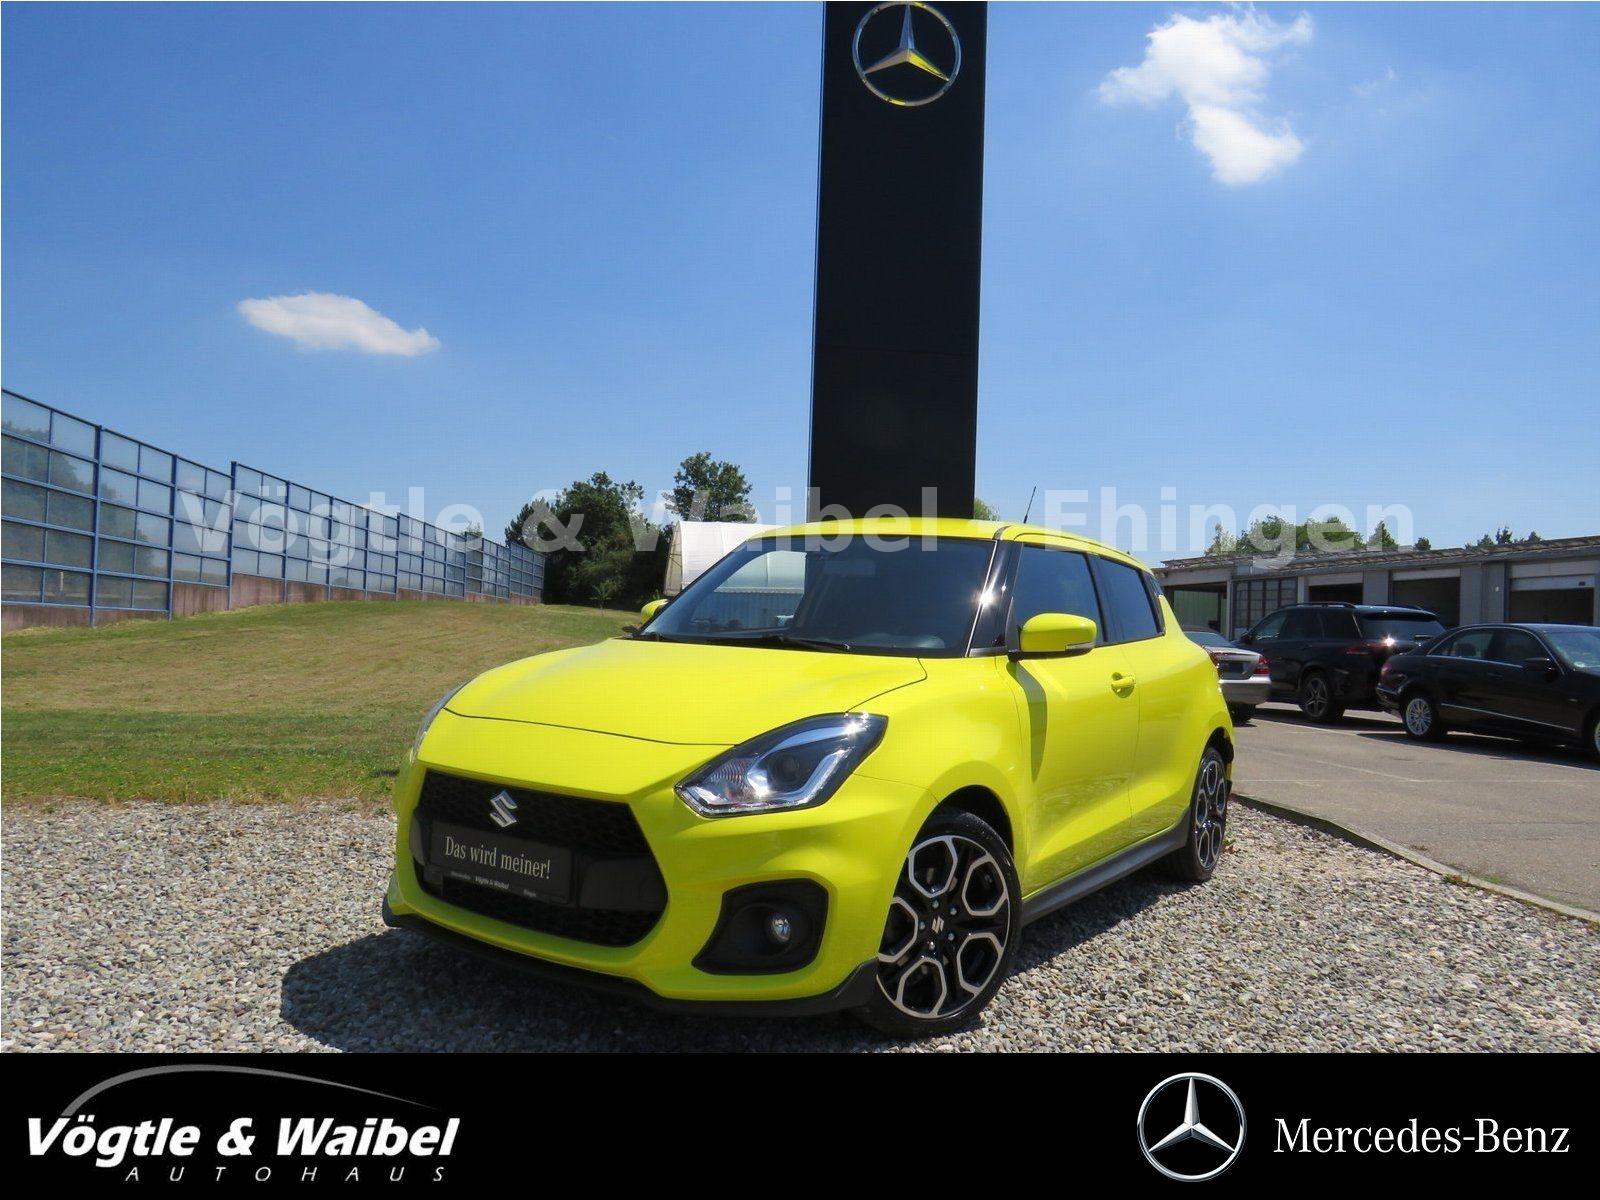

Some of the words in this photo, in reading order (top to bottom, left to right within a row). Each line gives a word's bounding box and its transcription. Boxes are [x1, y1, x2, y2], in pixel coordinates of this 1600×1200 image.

[445, 836, 466, 860] Das
[470, 845, 497, 868] wird
[501, 854, 551, 879] meiner!
